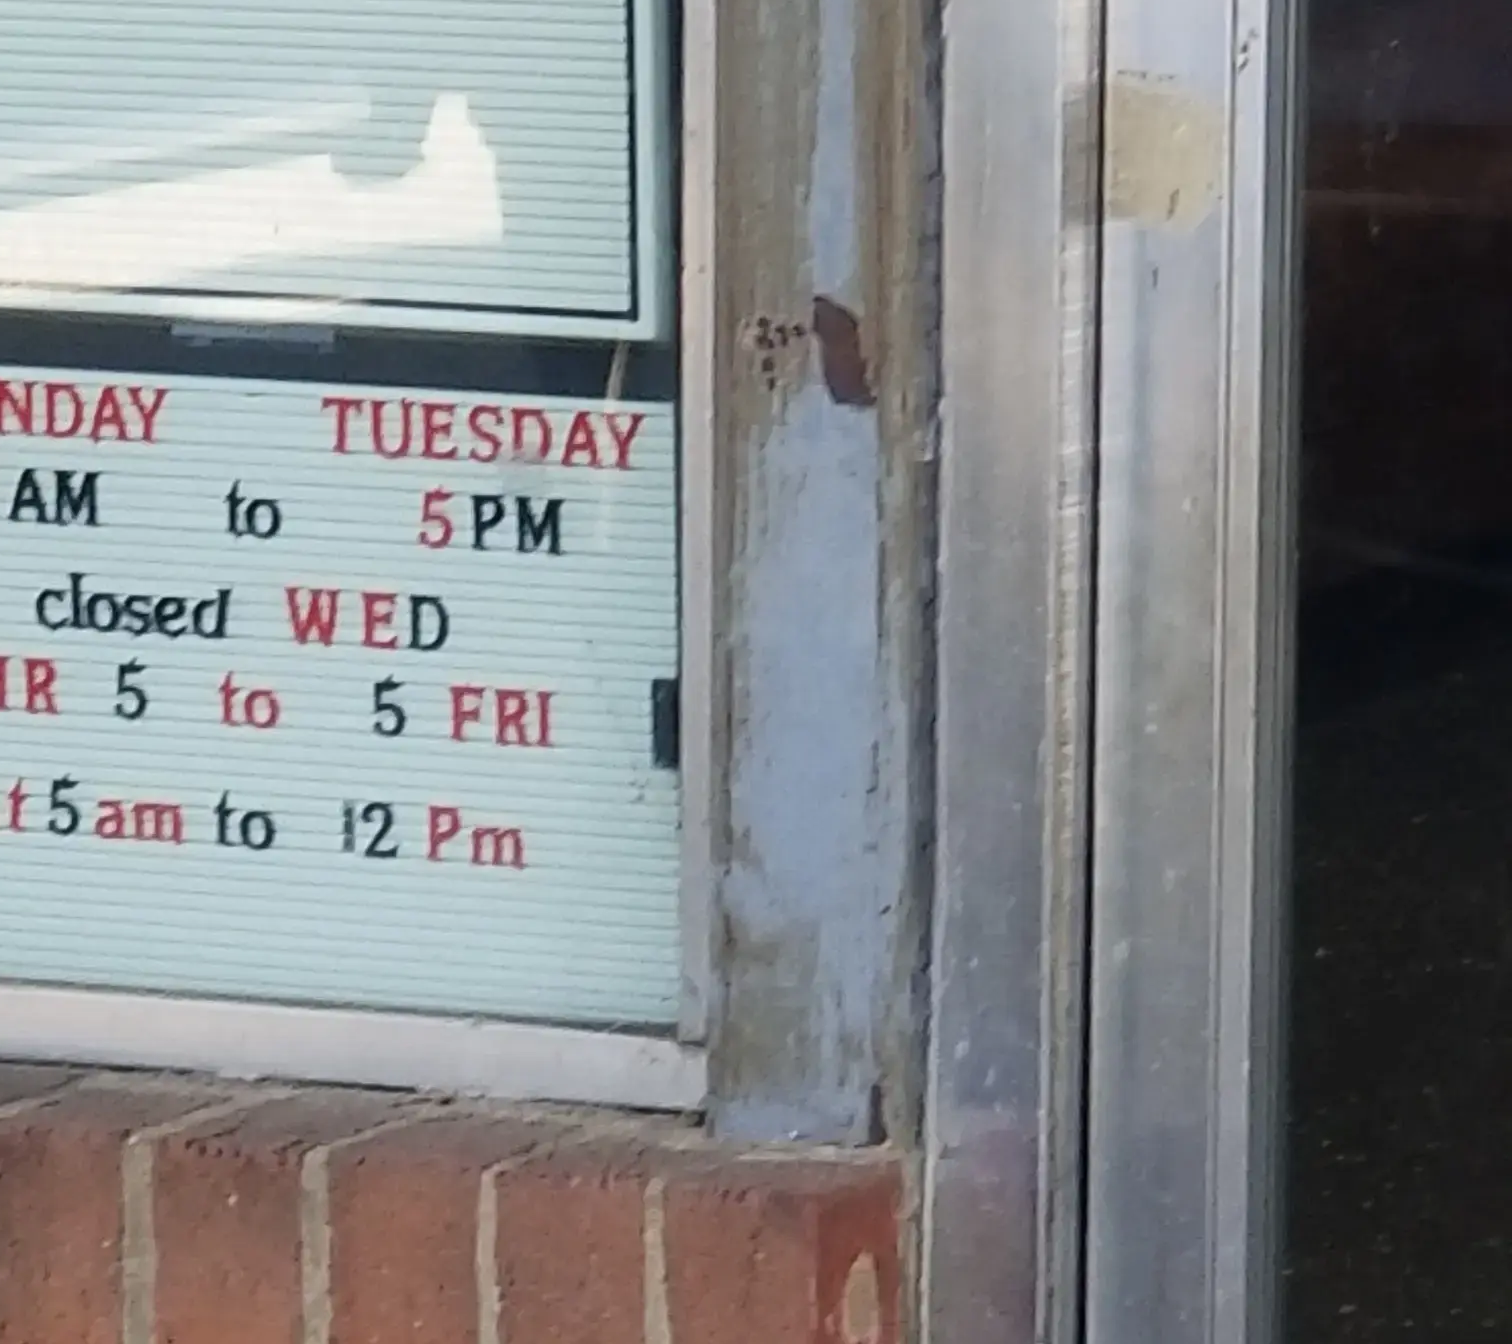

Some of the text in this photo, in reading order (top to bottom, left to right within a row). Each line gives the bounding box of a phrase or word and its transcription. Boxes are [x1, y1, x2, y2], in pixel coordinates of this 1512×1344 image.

[322, 397, 645, 470] TUESDAY
[224, 480, 281, 540] to
[35, 573, 450, 652] closed WED
[114, 659, 148, 720] 5
[219, 672, 280, 729] to
[373, 676, 406, 738] 5
[450, 685, 554, 747] FRI
[214, 790, 276, 851] to
